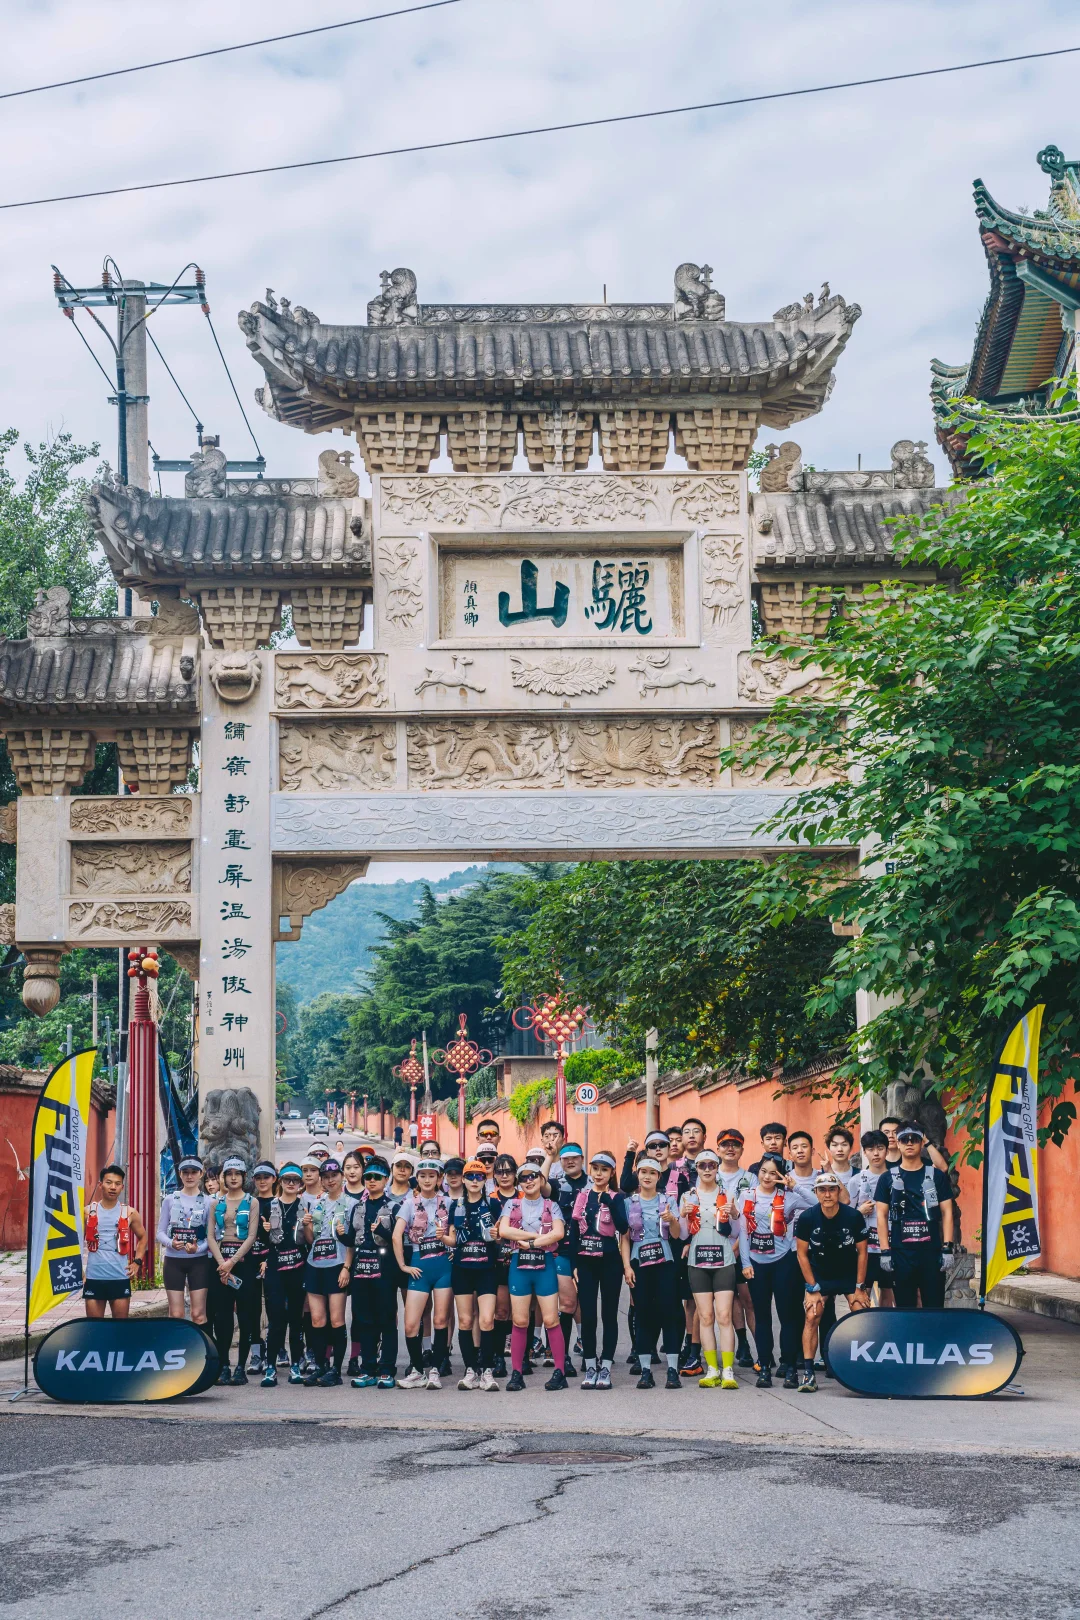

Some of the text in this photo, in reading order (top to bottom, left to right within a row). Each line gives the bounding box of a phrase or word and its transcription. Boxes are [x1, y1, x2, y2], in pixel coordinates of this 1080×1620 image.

[581, 1088, 593, 1100] 30
[420, 1116, 433, 1142] 停车
[1022, 1113, 1035, 1143] GRIP
[71, 1107, 82, 1181] POWER GRIP
[1007, 1244, 1039, 1257] KAILAS
[53, 1280, 84, 1293] KAILAS
[55, 1349, 187, 1372] KAILAS
[850, 1340, 994, 1366] KAILAS
